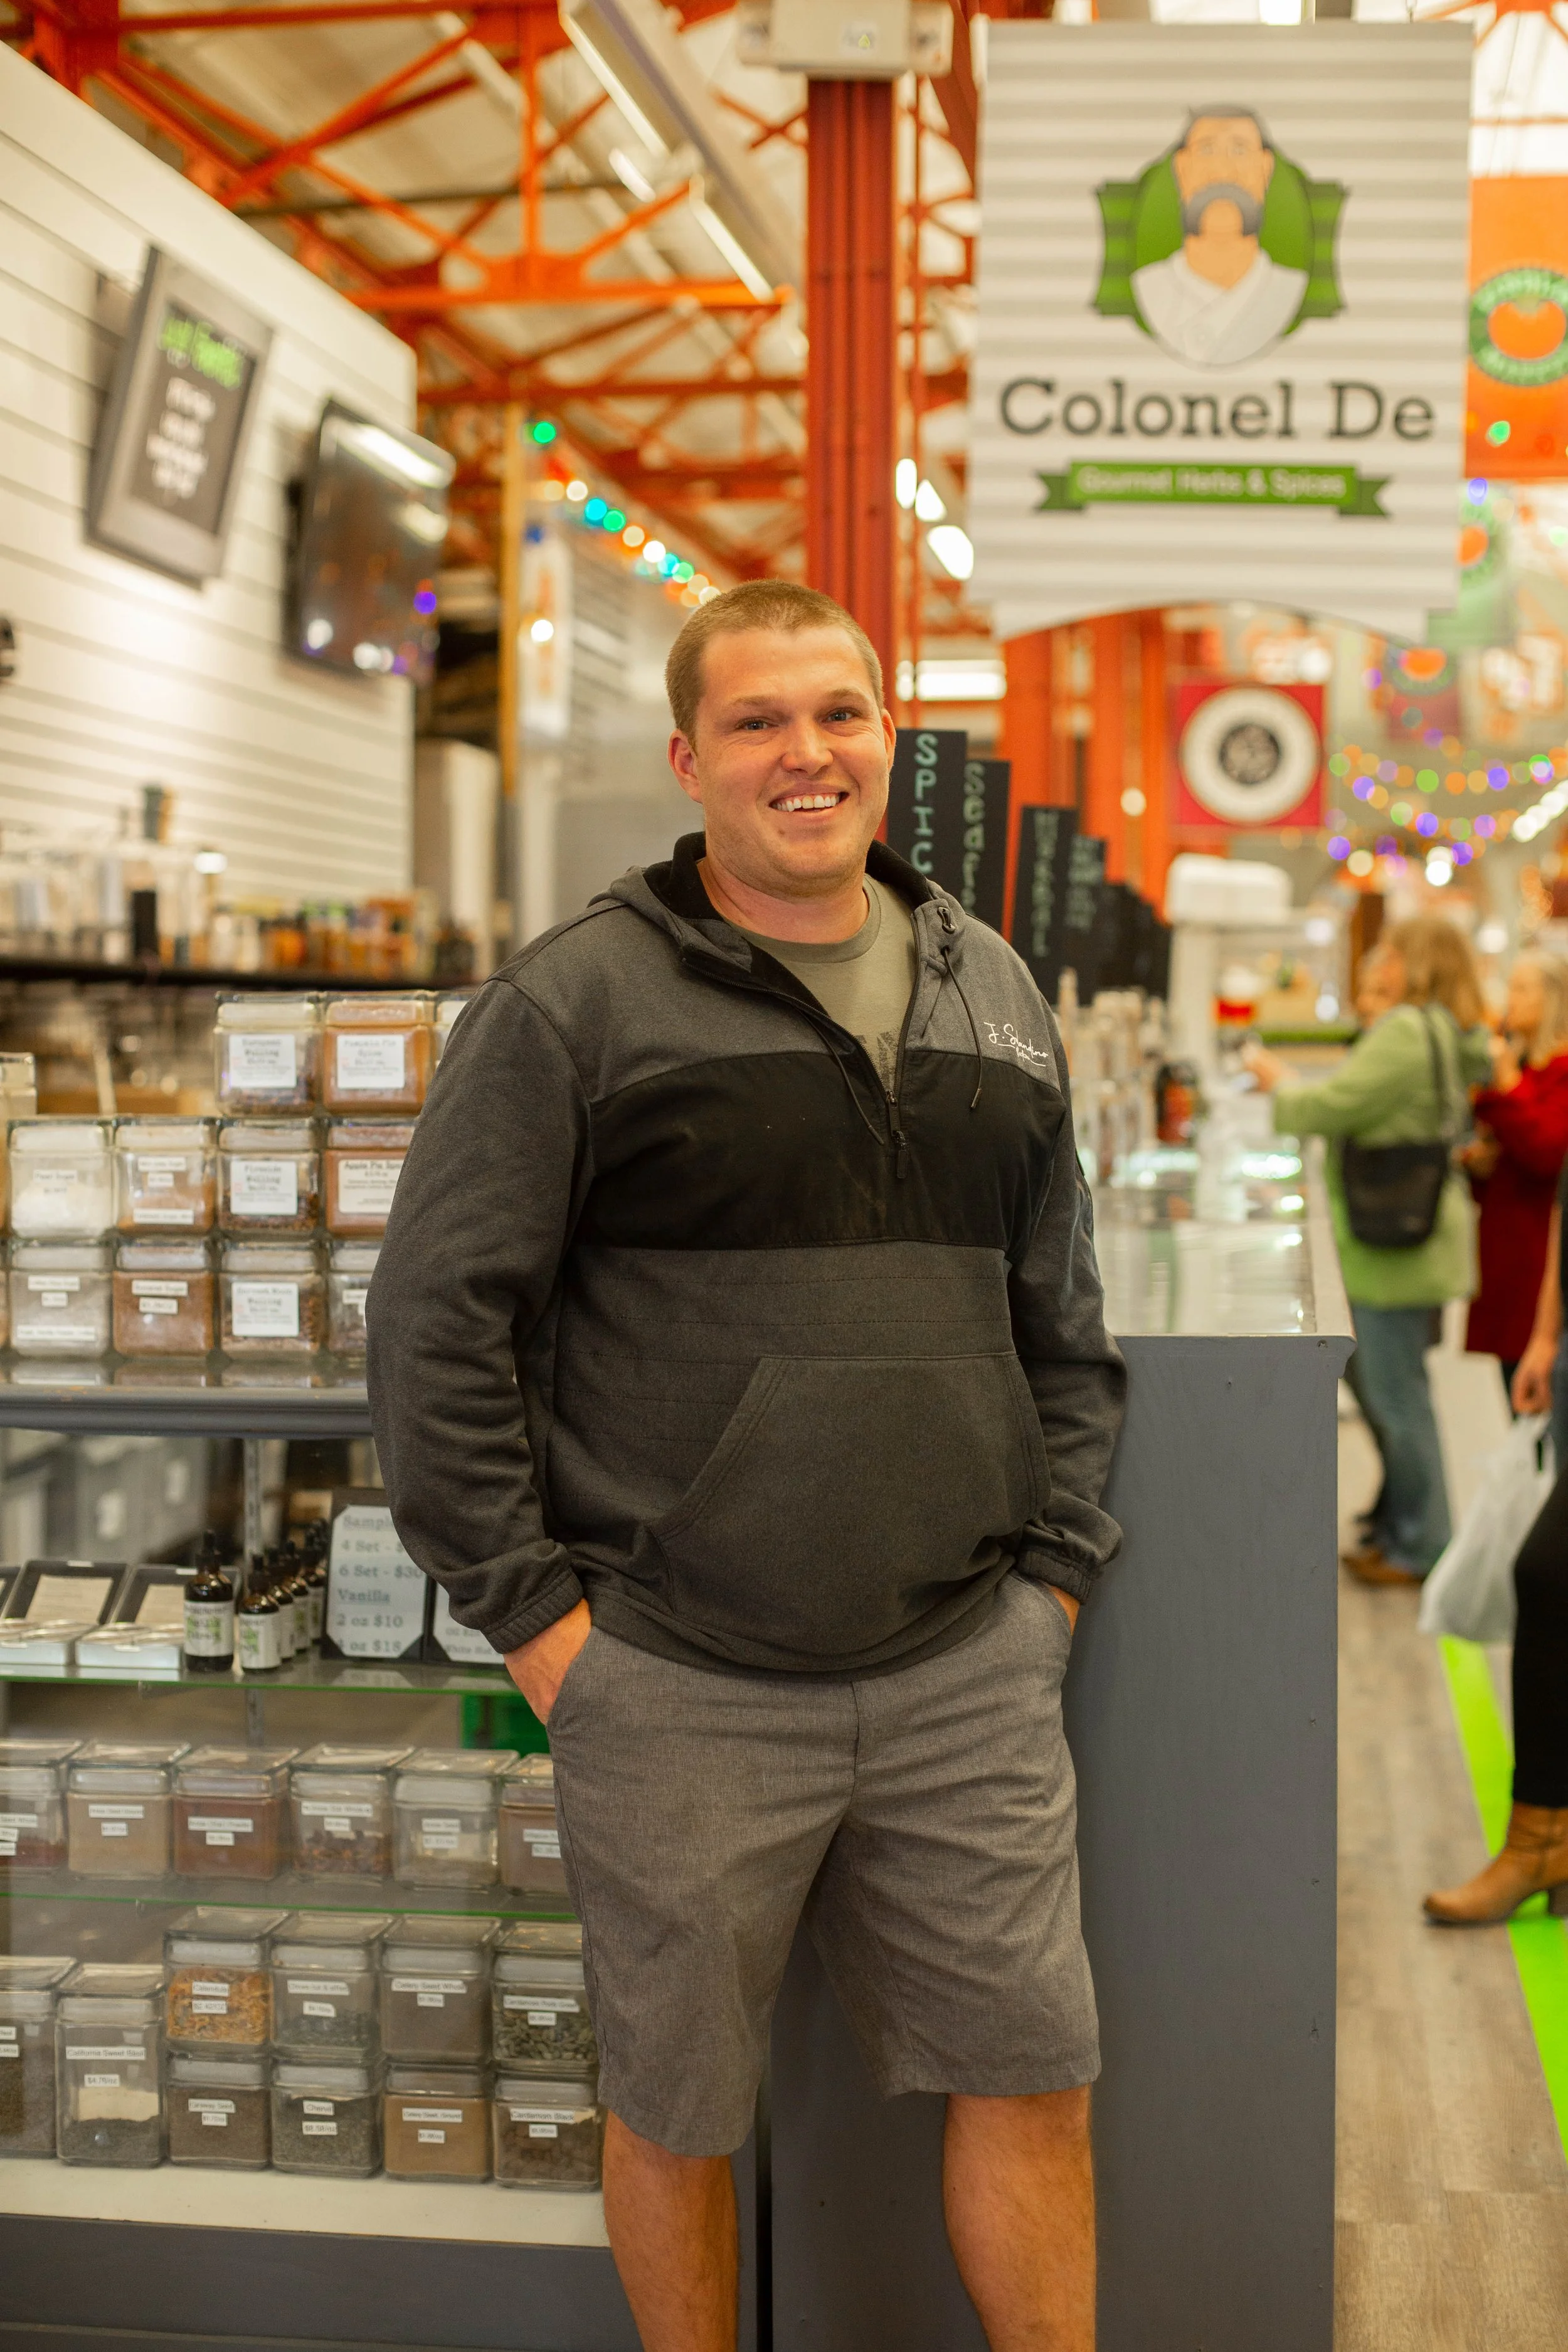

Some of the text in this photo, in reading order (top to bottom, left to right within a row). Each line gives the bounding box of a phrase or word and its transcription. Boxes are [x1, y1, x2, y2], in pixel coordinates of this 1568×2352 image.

[999, 376, 1435, 441] Colonel De
[1269, 468, 1347, 501] Spices
[355, 1540, 379, 1552] Set
[354, 1565, 378, 1577] Set
[337, 1588, 391, 1602] Vanilla
[336, 1613, 404, 1628] 2 oz $10
[349, 1641, 366, 1652] oz
